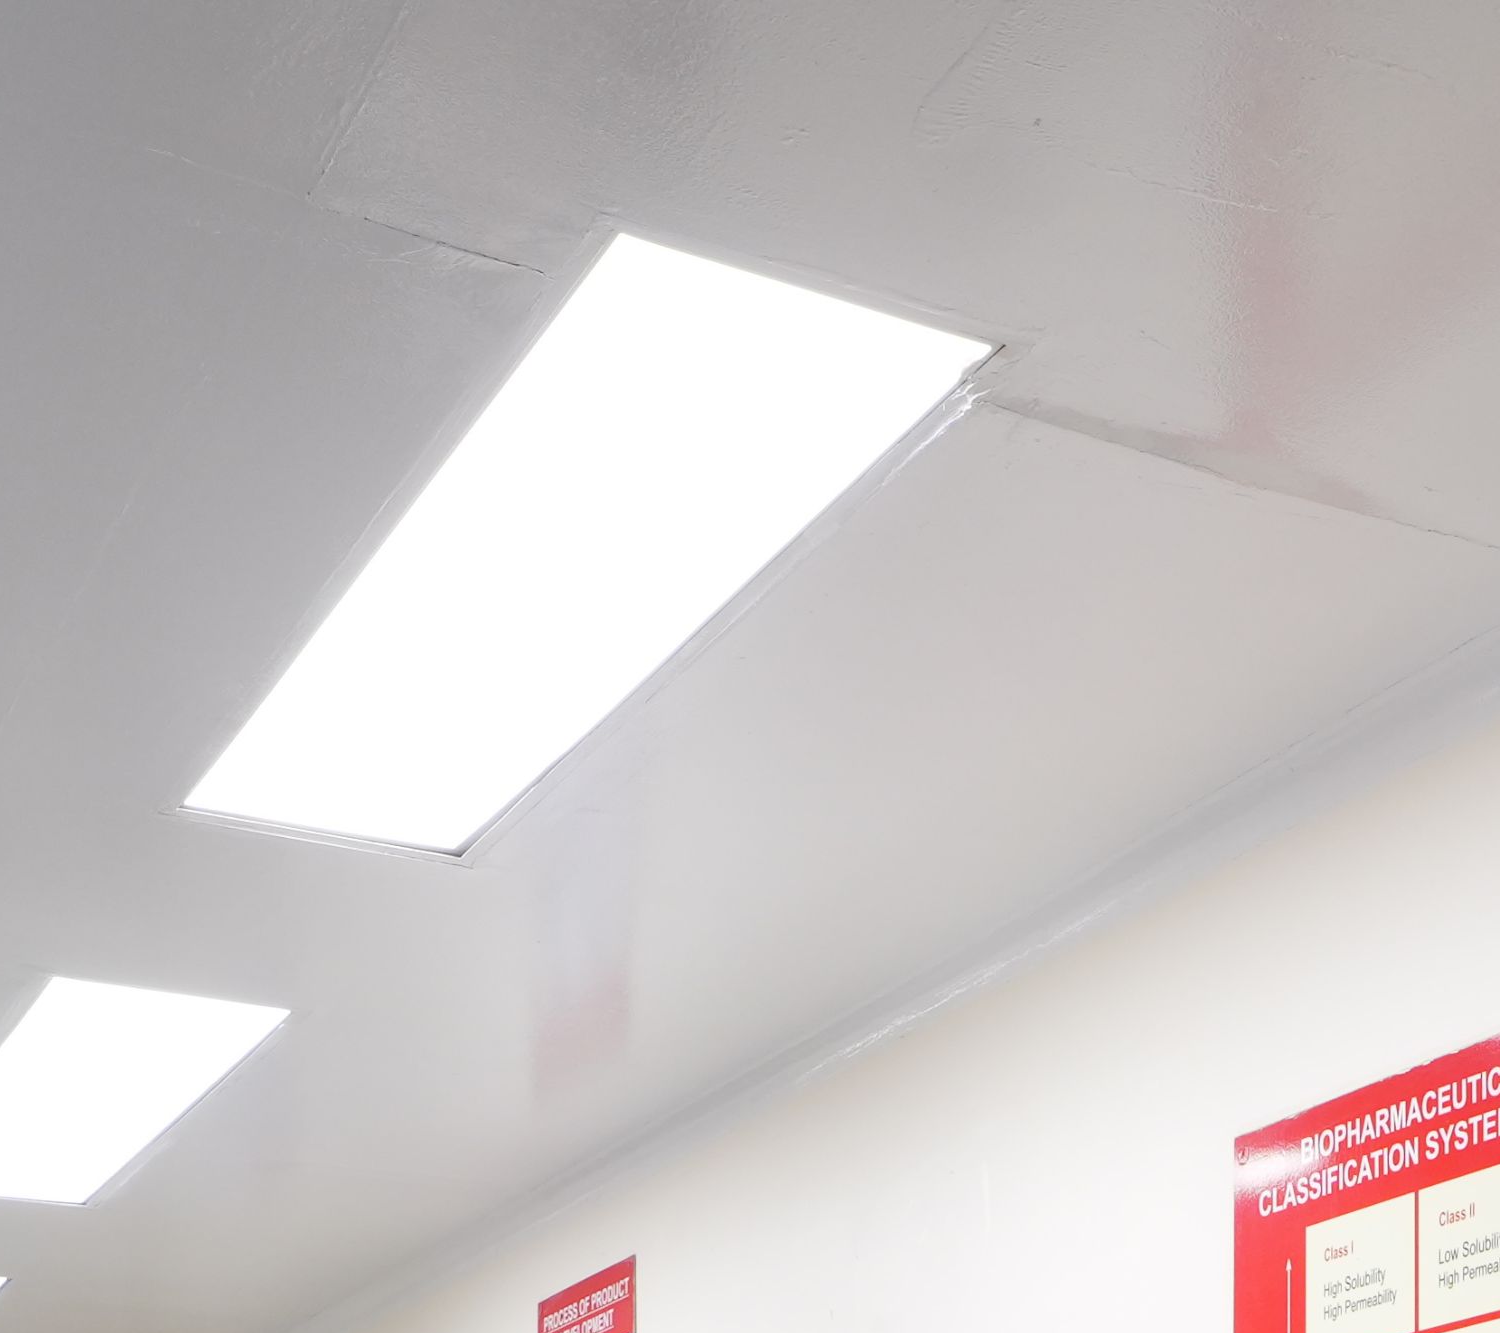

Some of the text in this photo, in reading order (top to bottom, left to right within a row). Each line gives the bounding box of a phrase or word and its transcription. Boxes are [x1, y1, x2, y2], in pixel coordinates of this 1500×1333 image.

[1258, 1137, 1419, 1217] CLASSIFICATION
[1439, 1207, 1467, 1227] Class
[1324, 1244, 1349, 1262] Class
[1438, 1247, 1459, 1264] Low
[1323, 1267, 1386, 1299] High Solubility
[1438, 1269, 1460, 1289] High
[543, 1276, 630, 1333] PROCESS OF PRODUCT
[1323, 1288, 1397, 1322] High Permeability
